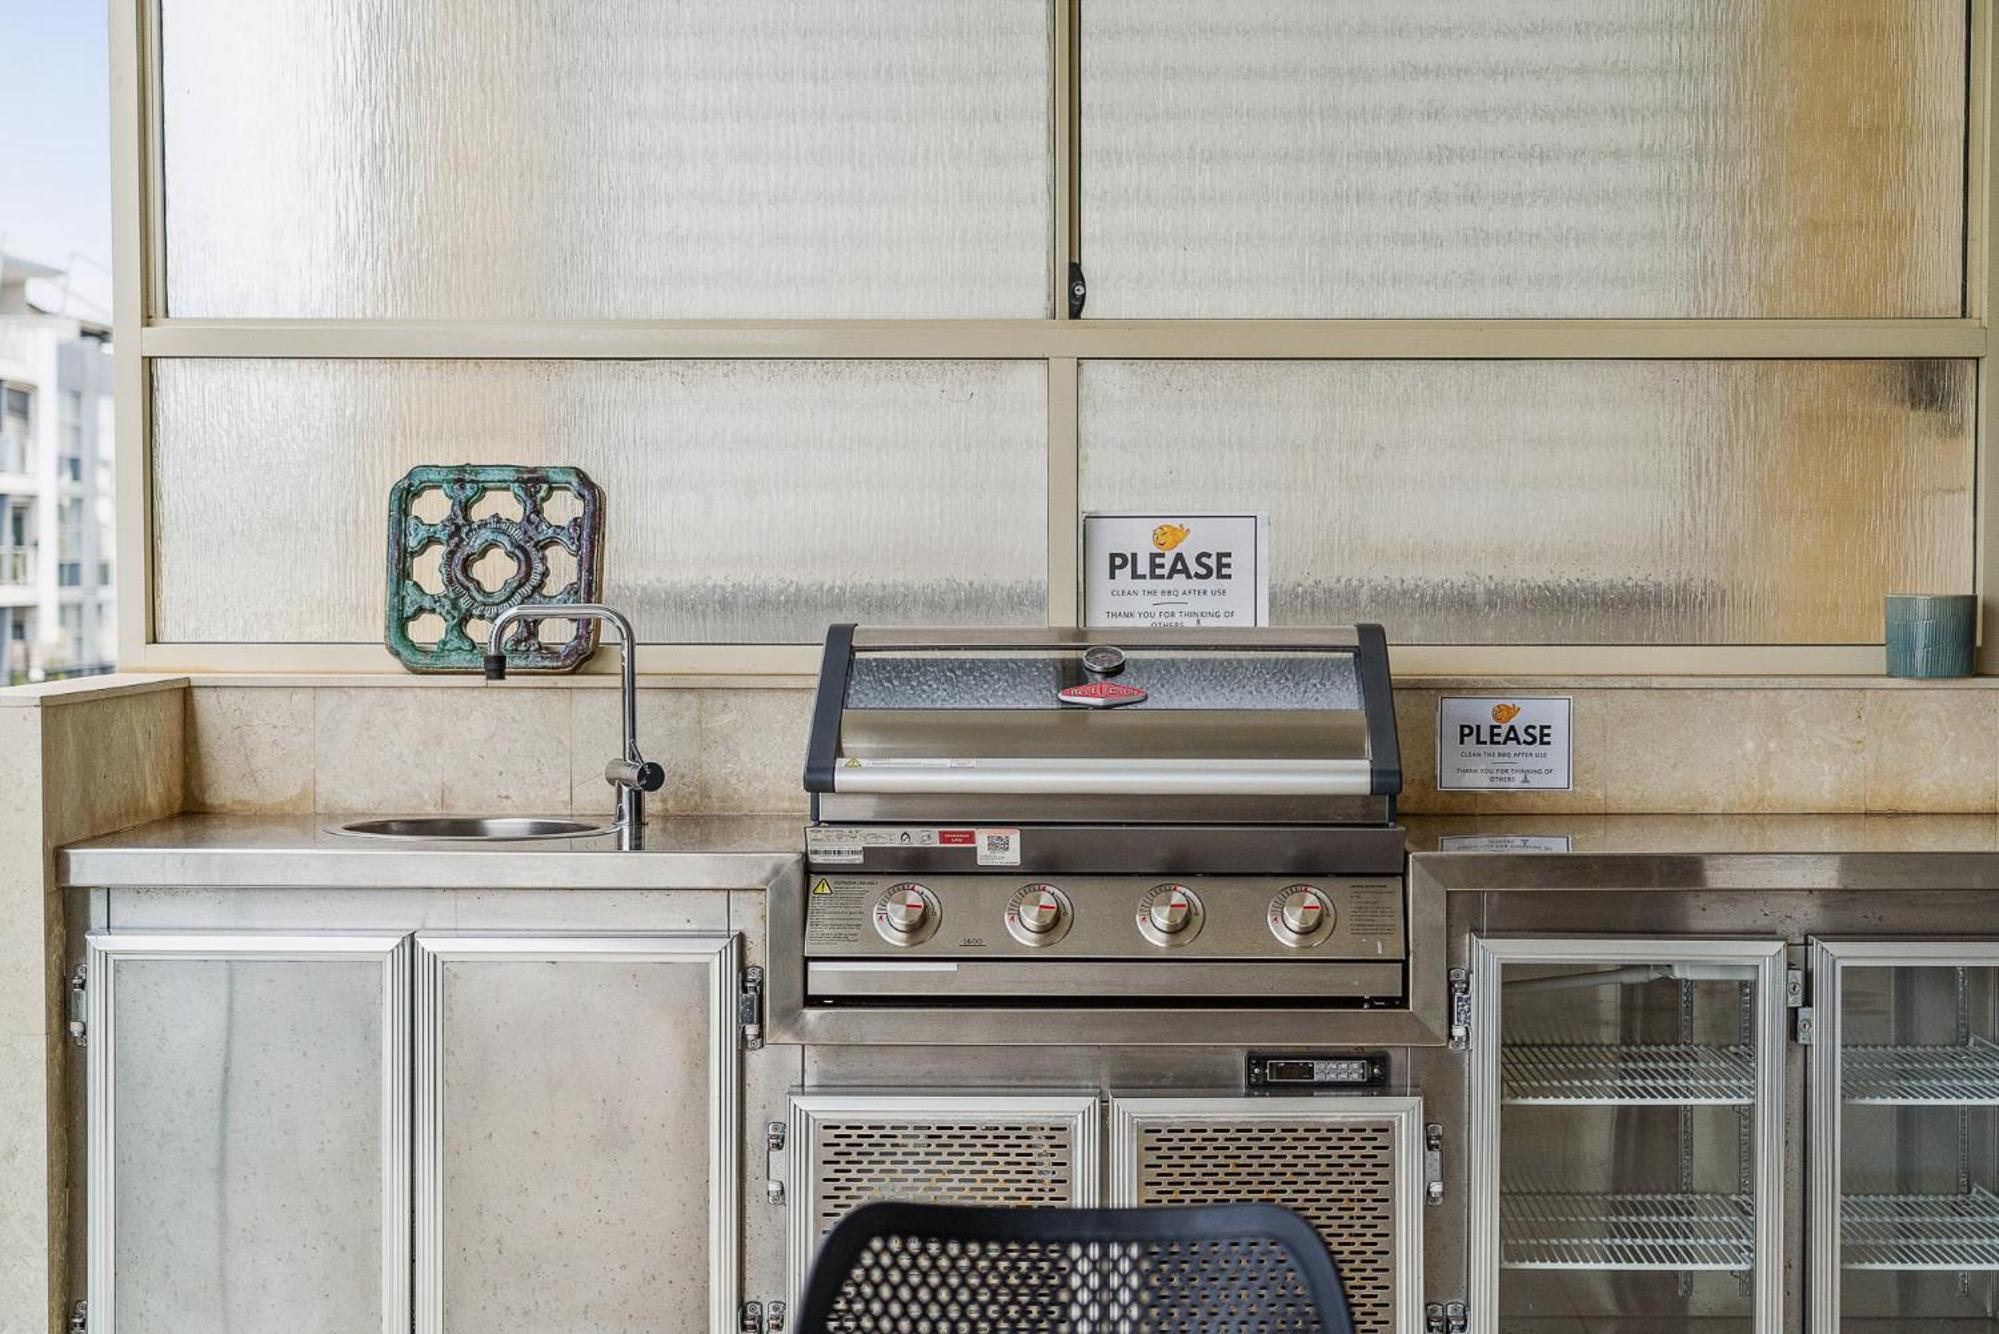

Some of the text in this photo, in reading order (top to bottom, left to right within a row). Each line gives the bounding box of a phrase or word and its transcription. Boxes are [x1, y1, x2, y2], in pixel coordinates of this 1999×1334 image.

[1109, 552, 1232, 580] PLEASE
[1111, 589, 1227, 597] CLEAN THE BBQ AFTER USE
[1106, 611, 1235, 619] THANK YOU FOR THINKING OF
[1459, 724, 1552, 745] PLEASE
